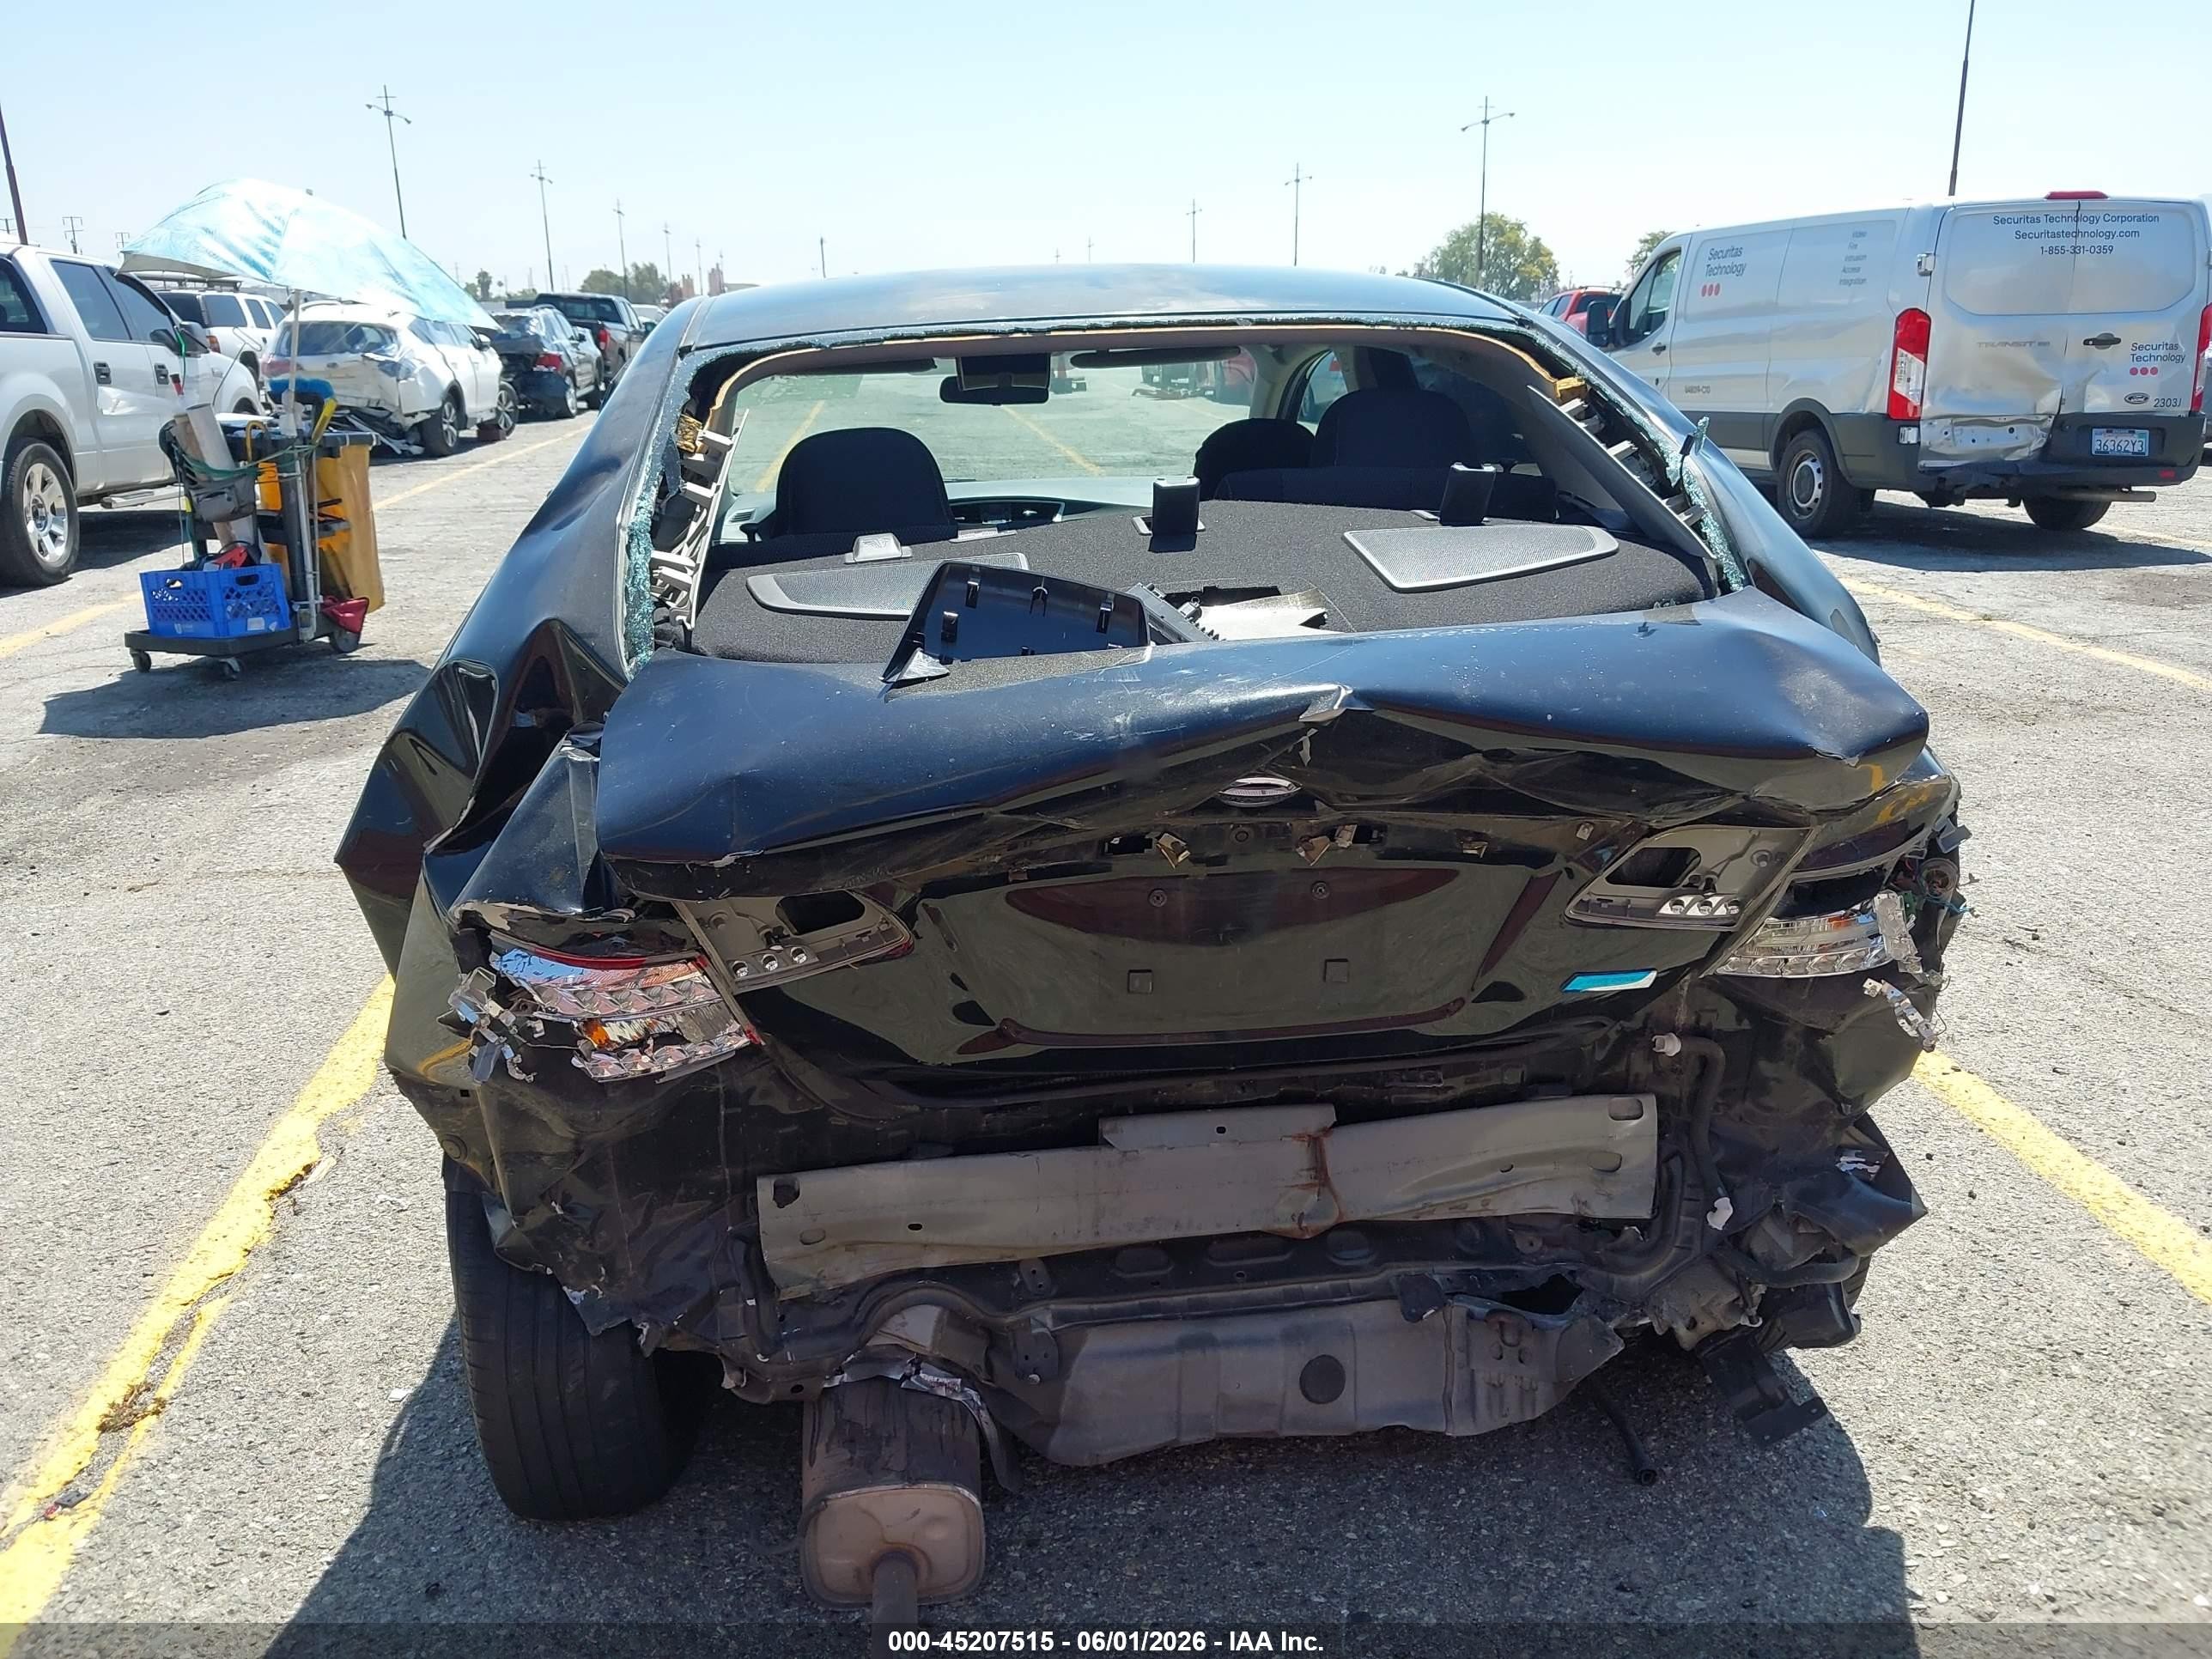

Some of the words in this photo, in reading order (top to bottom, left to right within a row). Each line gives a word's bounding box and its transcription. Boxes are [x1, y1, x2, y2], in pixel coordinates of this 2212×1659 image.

[1993, 215, 2041, 225] Securitas
[2044, 213, 2100, 225] Technology
[2103, 213, 2160, 224] Corporation
[2014, 229, 2140, 240] Securitastechnology.com
[1708, 246, 1743, 260] Securitas
[2040, 245, 2114, 255] 1-855-331-0359
[1705, 261, 1747, 277] Technology
[2130, 341, 2179, 351] Securitas
[2130, 353, 2185, 364] Technology
[2153, 398, 2182, 408] 2303J
[2096, 439, 2144, 452] 36362Y3
